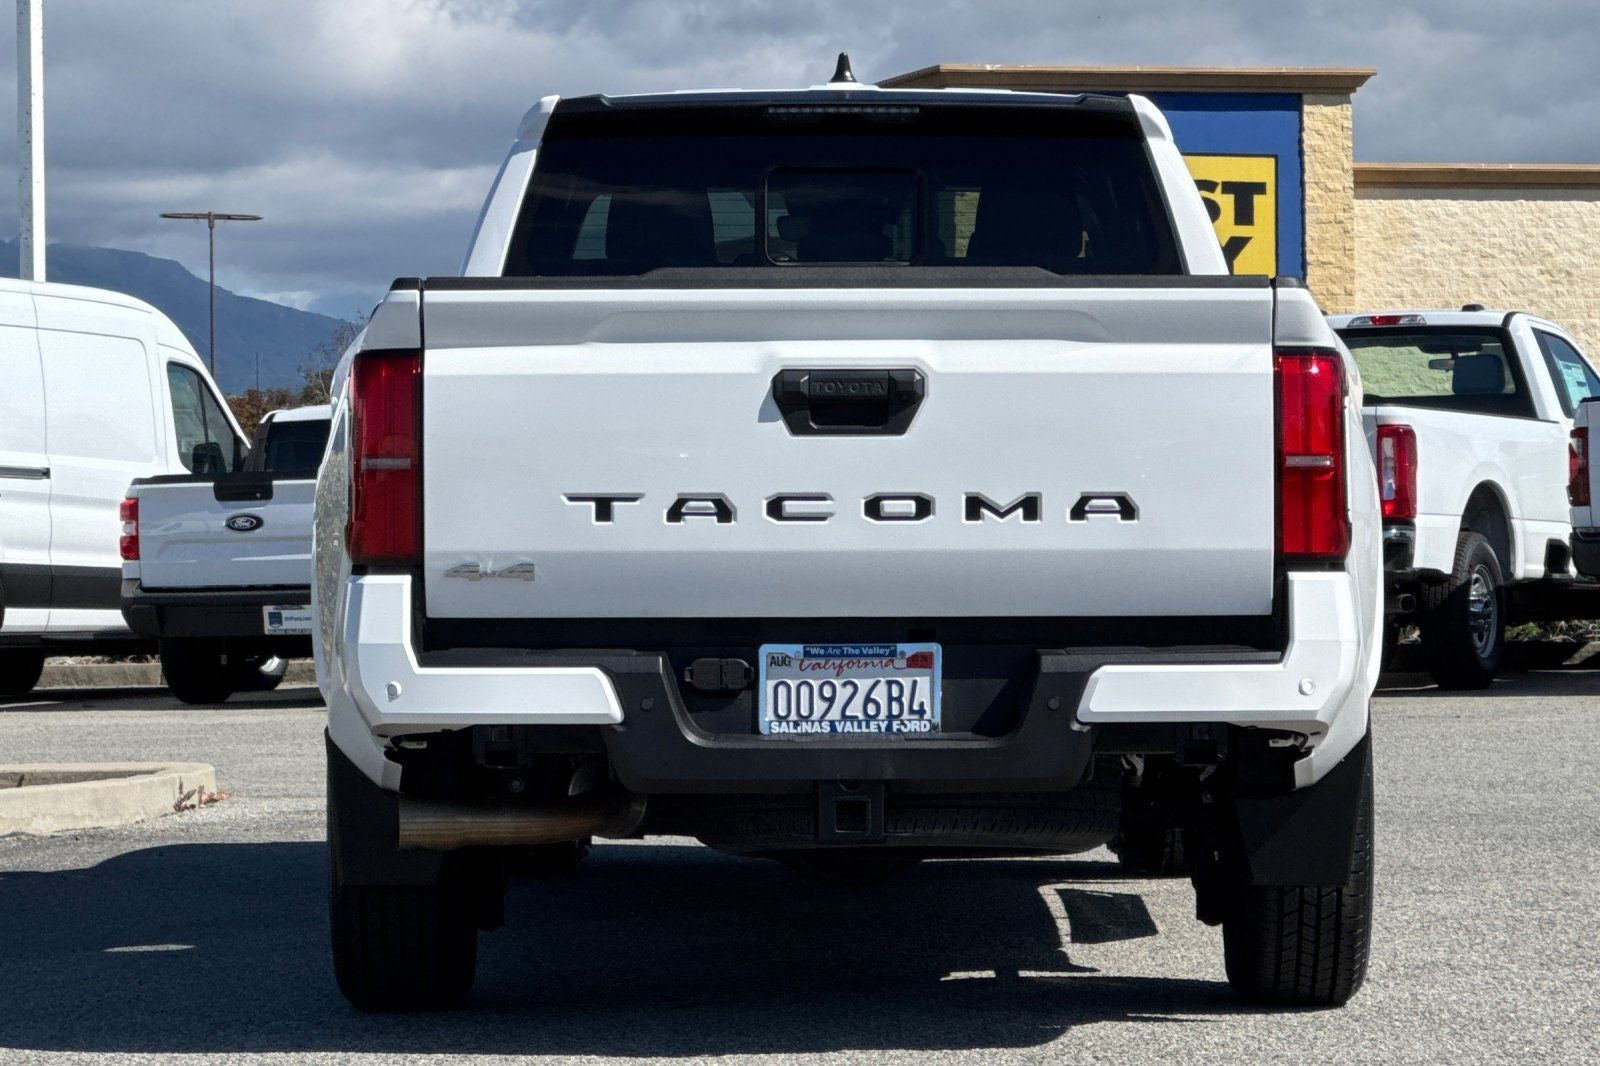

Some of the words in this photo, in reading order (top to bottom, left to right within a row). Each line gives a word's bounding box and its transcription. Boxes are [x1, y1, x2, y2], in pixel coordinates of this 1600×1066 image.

[814, 381, 886, 394] TOYOTA
[561, 491, 1140, 526] TACOMA
[842, 647, 860, 655] The
[769, 655, 792, 667] AUG
[798, 658, 904, 677] California
[773, 679, 927, 720] 00926B4
[834, 721, 888, 733] VALLEY
[892, 720, 931, 733] FORD
